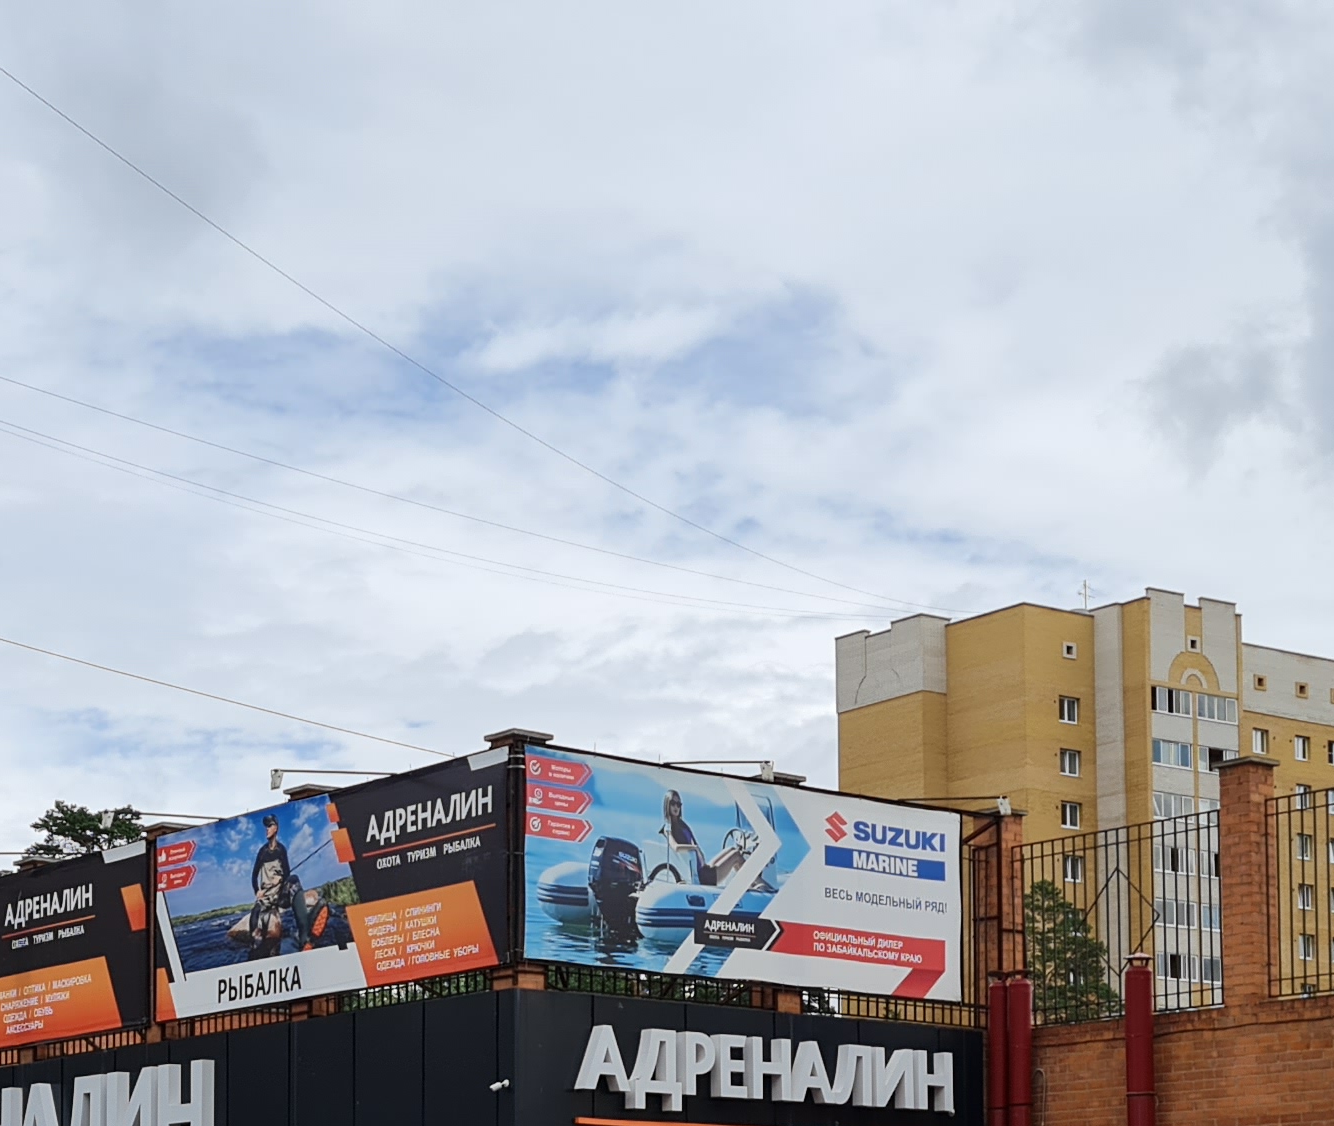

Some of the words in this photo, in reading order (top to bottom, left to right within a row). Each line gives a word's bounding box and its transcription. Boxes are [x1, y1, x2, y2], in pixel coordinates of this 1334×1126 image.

[365, 785, 493, 846] АДРЕНАЛИН
[376, 854, 401, 870] ОХОТА
[407, 846, 437, 863] ТУРИЗМ
[443, 836, 481, 855] РЫБАЛКА
[853, 820, 946, 853] SUZUKI
[852, 850, 919, 877] MARINE
[4, 883, 93, 930] АДРЕНАЛИН
[824, 887, 853, 901] ВЕСЬ
[855, 891, 922, 911] МОДЕЛЬНЫЙ
[925, 900, 948, 914] РЯД!
[703, 919, 755, 934] АДРЕНАЛИН
[813, 930, 876, 949] ОФИЦИАЛЬНЫЙ
[877, 938, 903, 950] ДИЛЕР
[813, 942, 825, 953] ПО
[826, 943, 899, 962] ЗАБАЙКАЛЬСКОМУ
[900, 952, 923, 965] КРАЮ
[217, 965, 302, 1004] РЫБАЛКА
[574, 1024, 954, 1114] АДРЕНАЛИН
